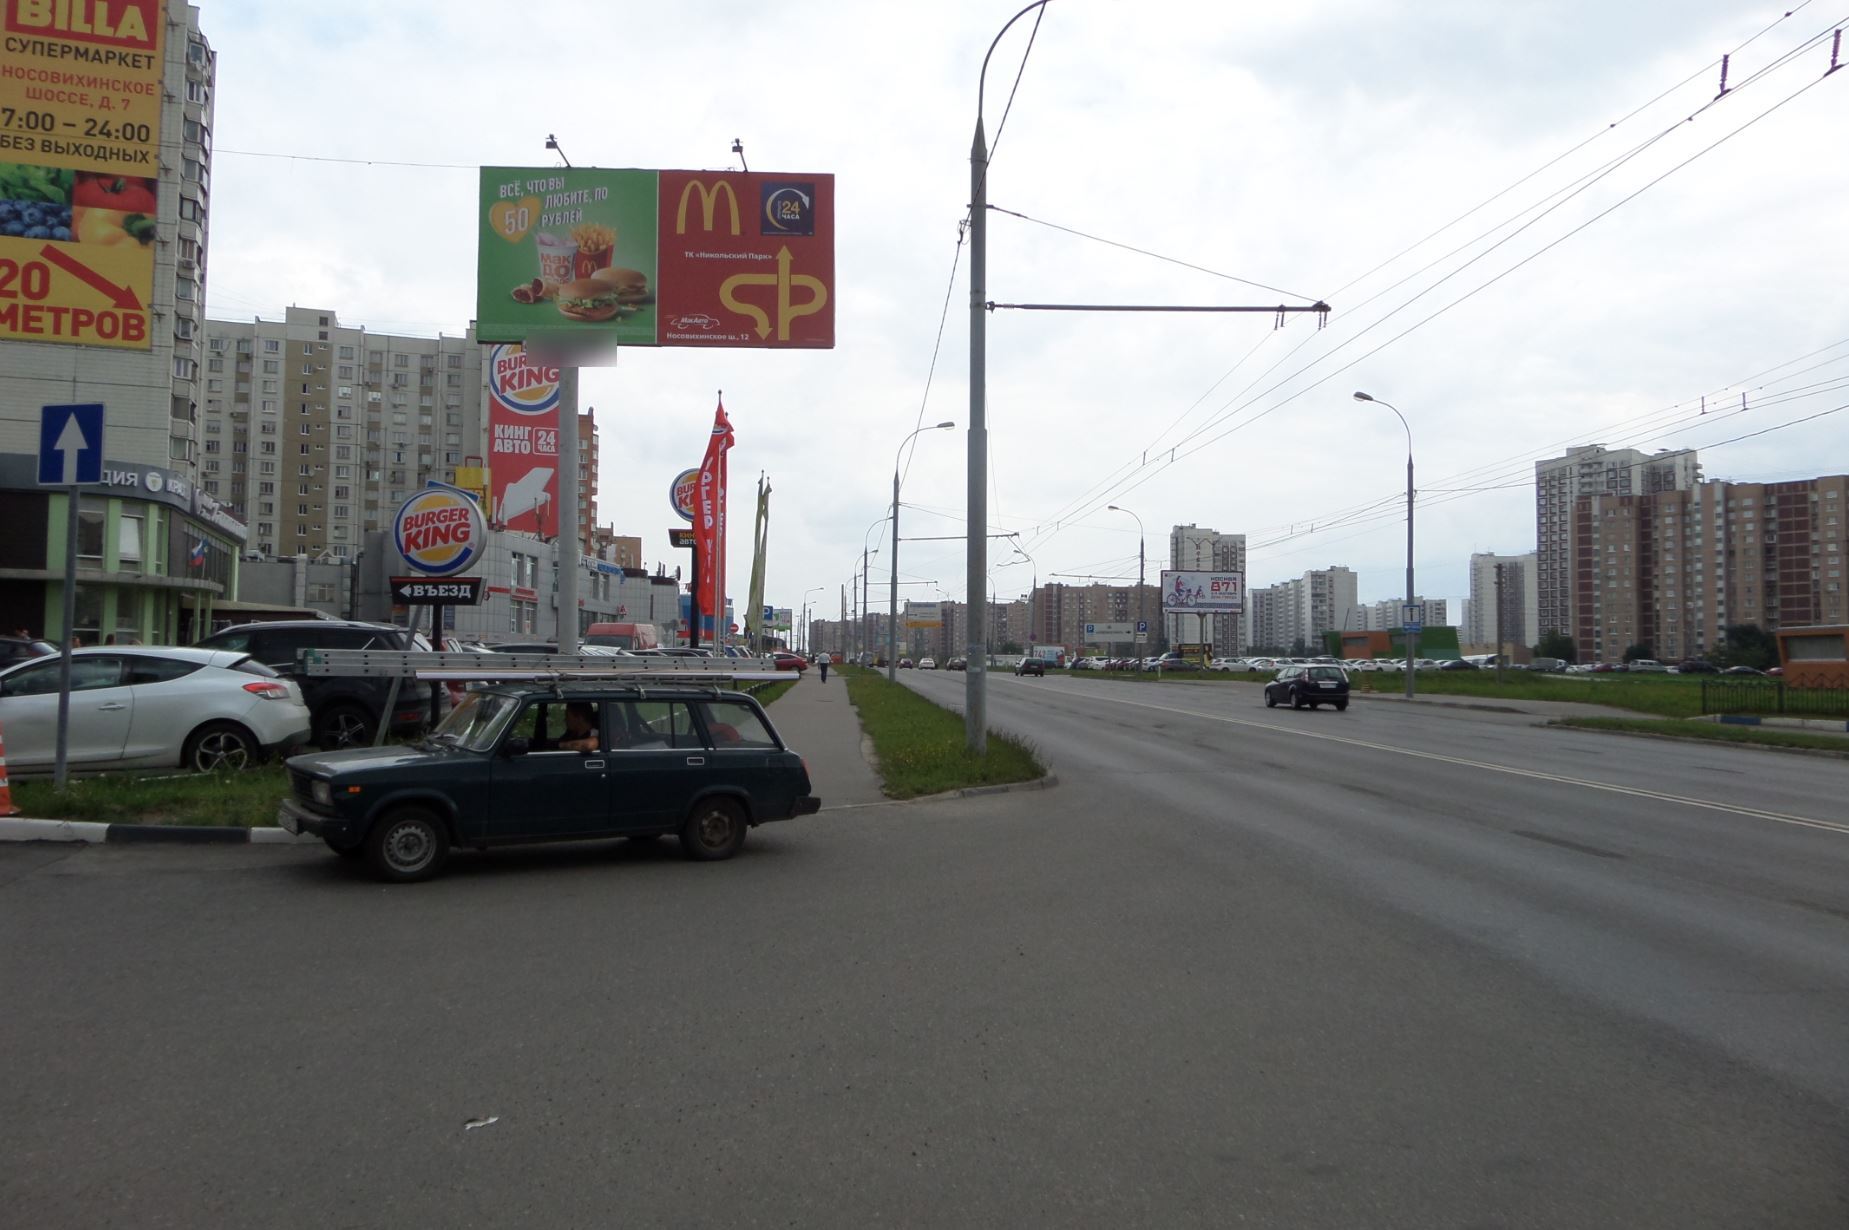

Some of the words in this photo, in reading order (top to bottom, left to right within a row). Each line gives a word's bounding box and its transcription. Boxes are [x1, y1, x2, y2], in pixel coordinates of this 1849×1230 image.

[16, 0, 149, 42] BILLA
[5, 36, 156, 70] СУПЕРМАРКЕТ
[1, 63, 156, 97] НОСОВИХИНСКОЕ
[25, 86, 94, 109] ШОССЕ,
[99, 96, 116, 112] Д.
[121, 98, 131, 111] 7
[1, 107, 55, 133] 7:00
[84, 117, 151, 143] 24:00
[0, 133, 35, 152] БЕЗ
[40, 138, 151, 164] ВЫХОДНЫХ
[499, 180, 524, 199] ВСЁ,
[526, 179, 547, 194] ЧТО
[547, 176, 565, 191] ВЫ
[544, 189, 593, 210] ЛЮБИТЕ,
[593, 186, 608, 202] ПО
[541, 207, 583, 228] РУБЛЕЙ
[782, 201, 800, 214] 24
[504, 207, 529, 235] 50
[684, 251, 695, 259] ТК
[695, 252, 748, 260] «Никольский
[747, 253, 773, 261] Парк»
[0, 303, 146, 342] МЕТРОВ
[500, 366, 559, 395] KING
[493, 438, 531, 455] АВТО
[494, 424, 531, 440] КИНГ
[538, 430, 556, 445] 24
[403, 507, 470, 533] BURGER
[403, 521, 471, 555] KING
[412, 583, 472, 599] ВЪЕЗД
[1210, 581, 1238, 592] 871
